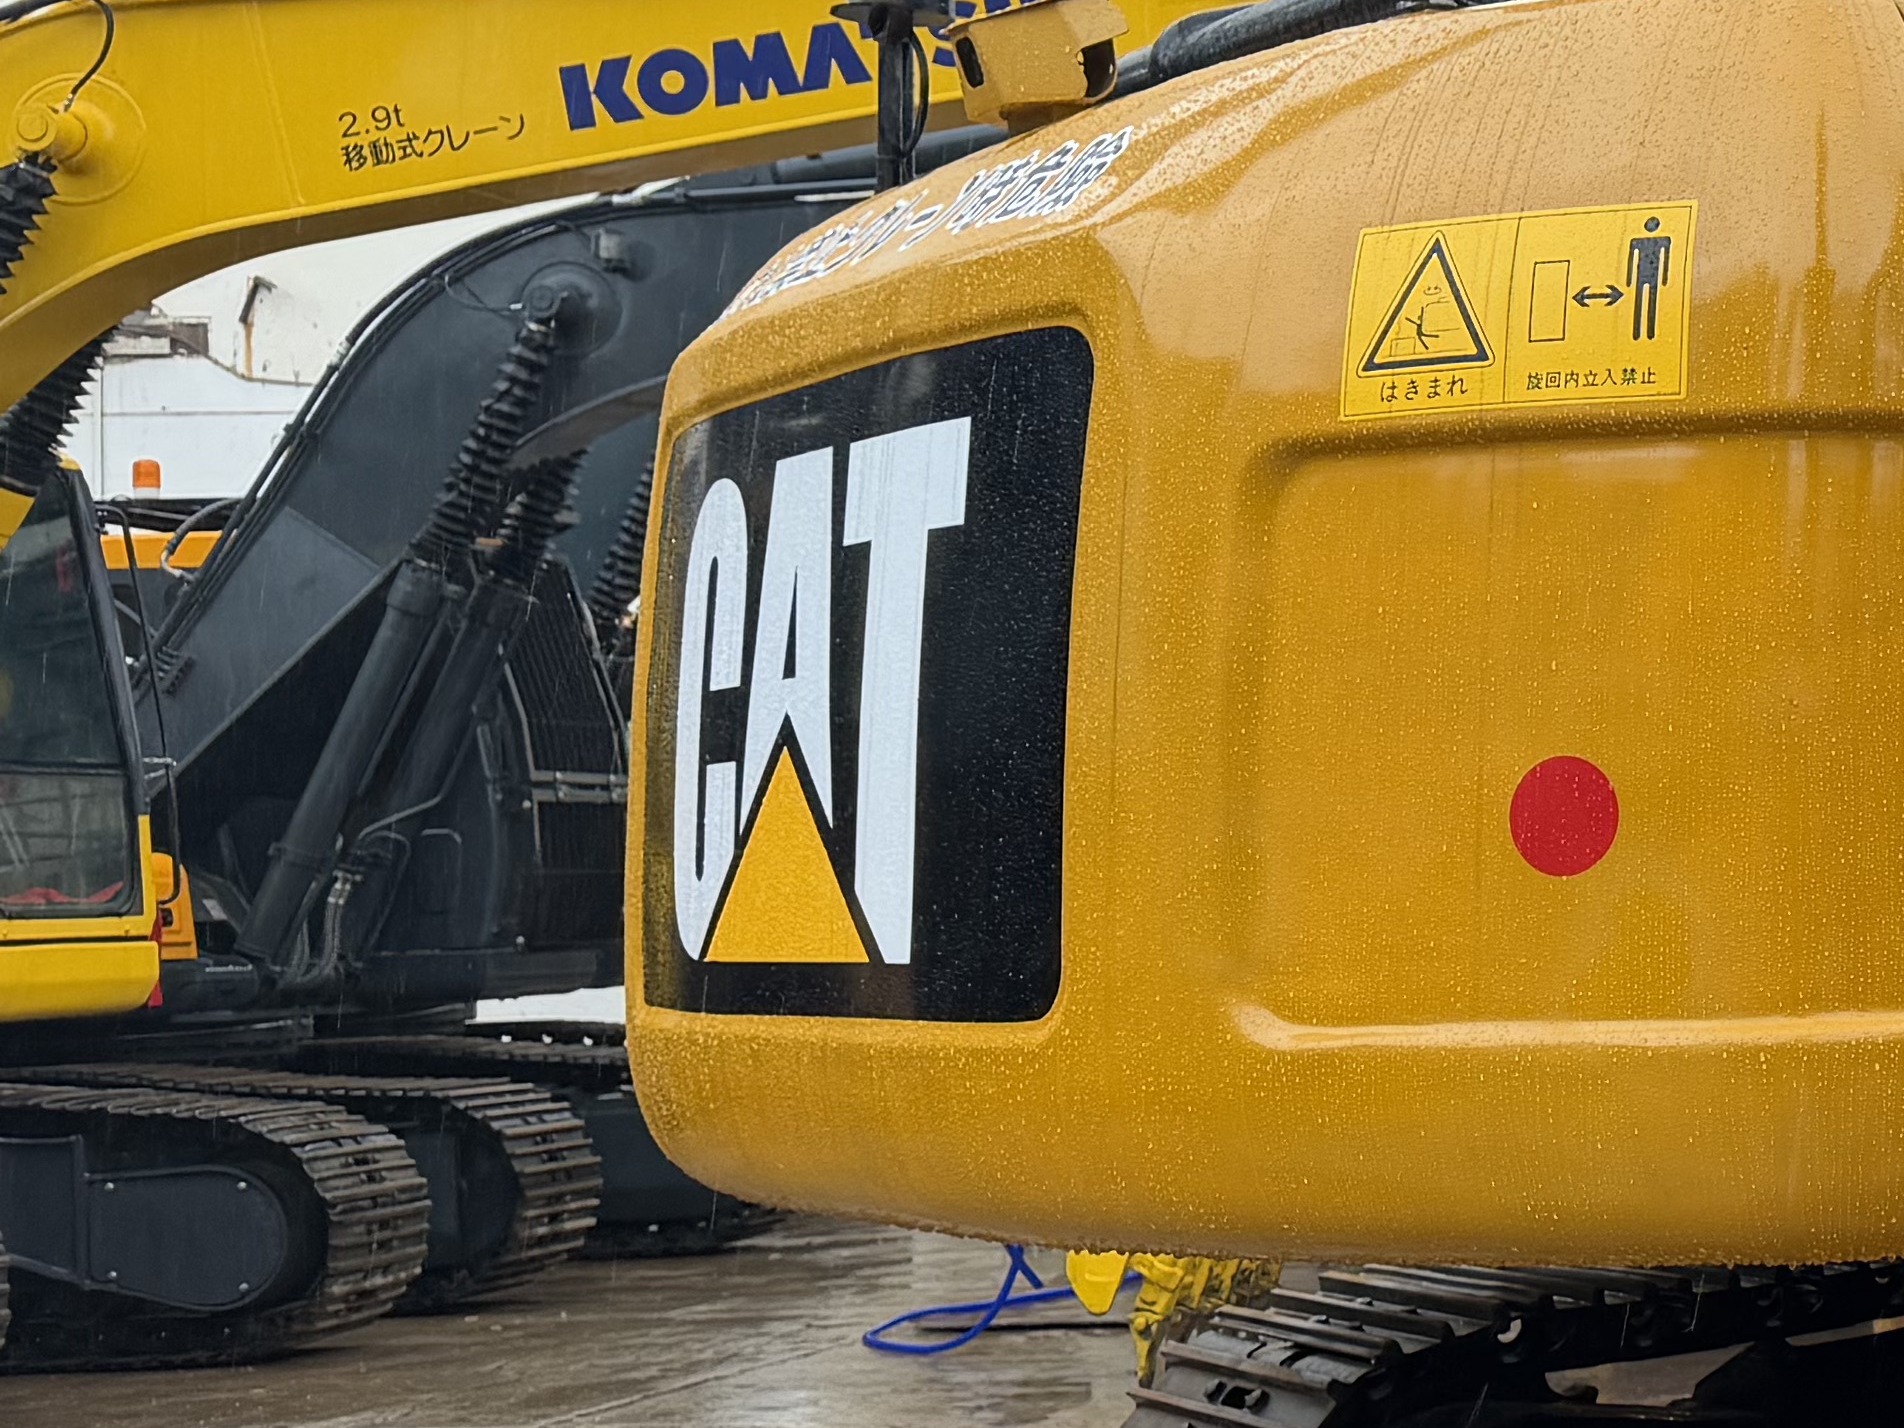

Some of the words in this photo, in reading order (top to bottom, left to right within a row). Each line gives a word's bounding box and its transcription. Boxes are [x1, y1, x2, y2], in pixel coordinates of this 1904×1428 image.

[338, 103, 406, 138] 2.9t
[340, 113, 526, 172] 移動式クレーン
[1525, 367, 1658, 391] 旋回内立入禁止
[673, 417, 972, 965] CAT
